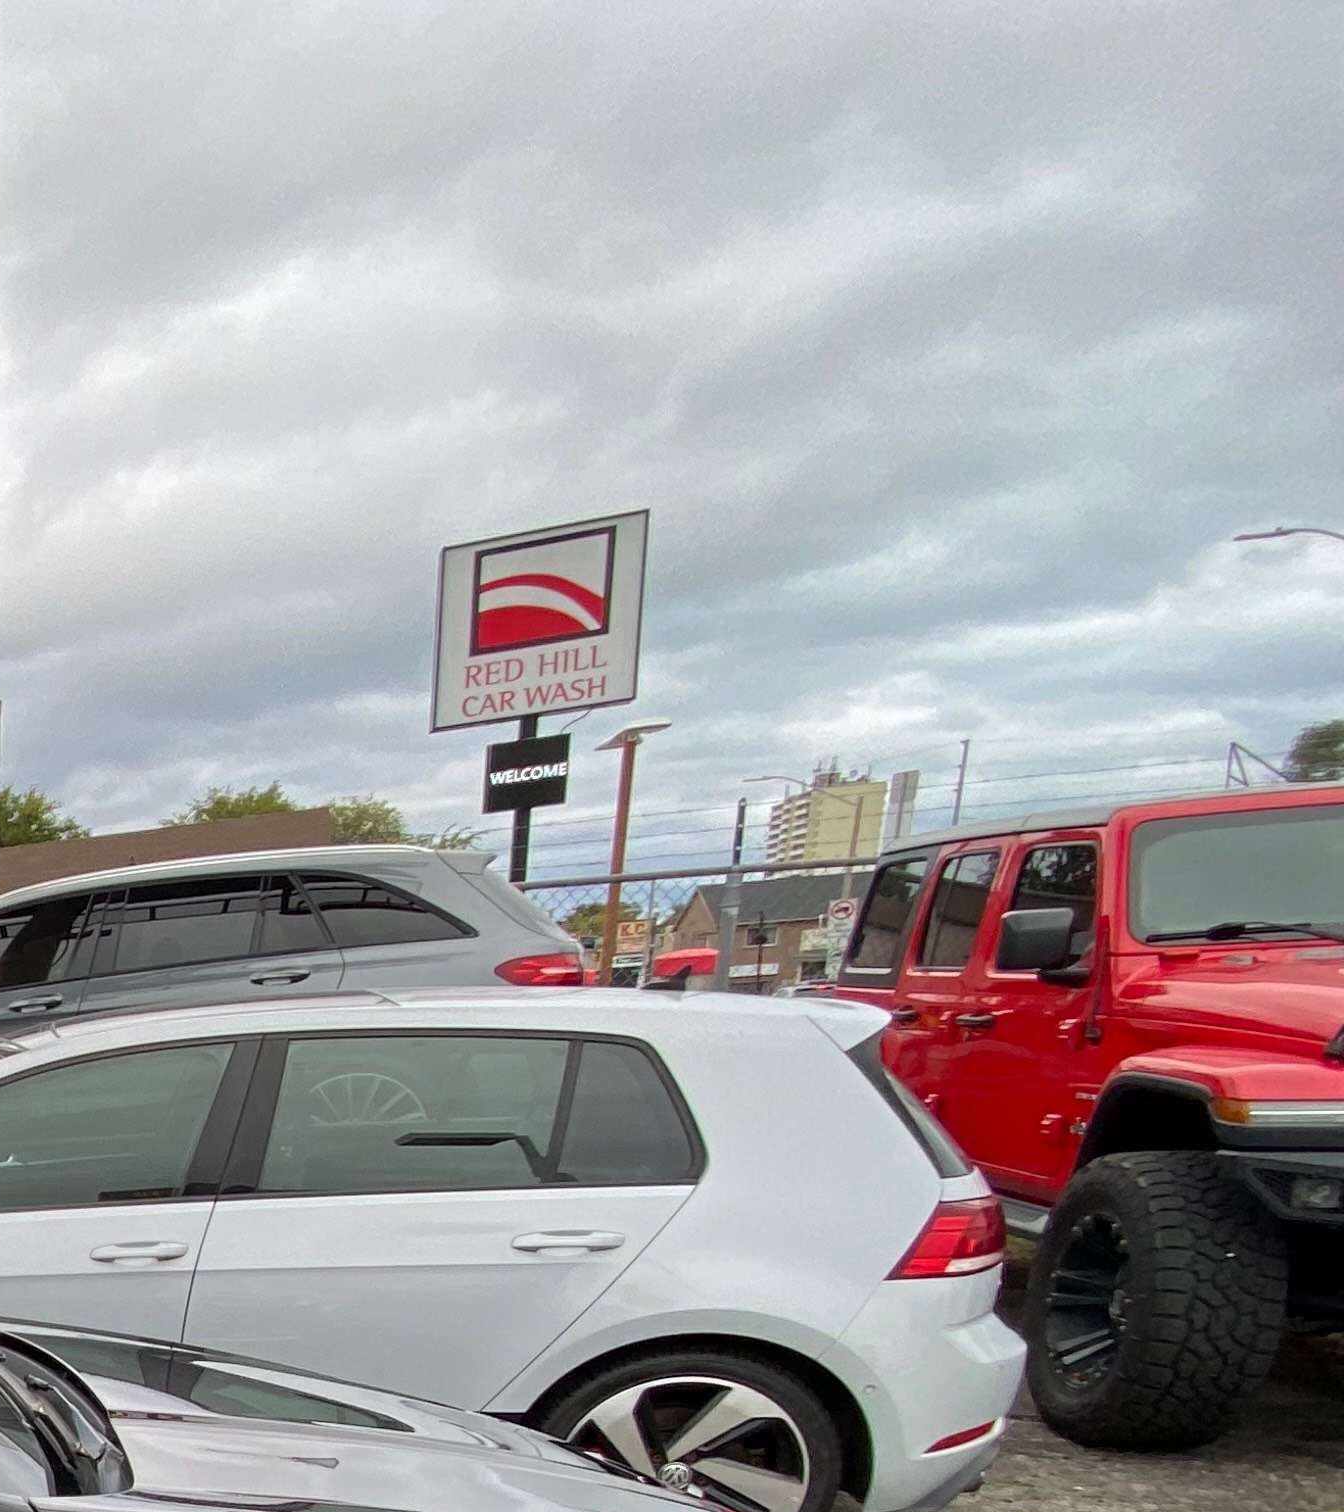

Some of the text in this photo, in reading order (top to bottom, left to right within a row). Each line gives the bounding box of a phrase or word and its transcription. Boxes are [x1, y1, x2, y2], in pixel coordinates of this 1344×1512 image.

[464, 645, 608, 689] RED HILL
[462, 675, 607, 718] CAR WASH
[489, 761, 569, 785] WELCOME
